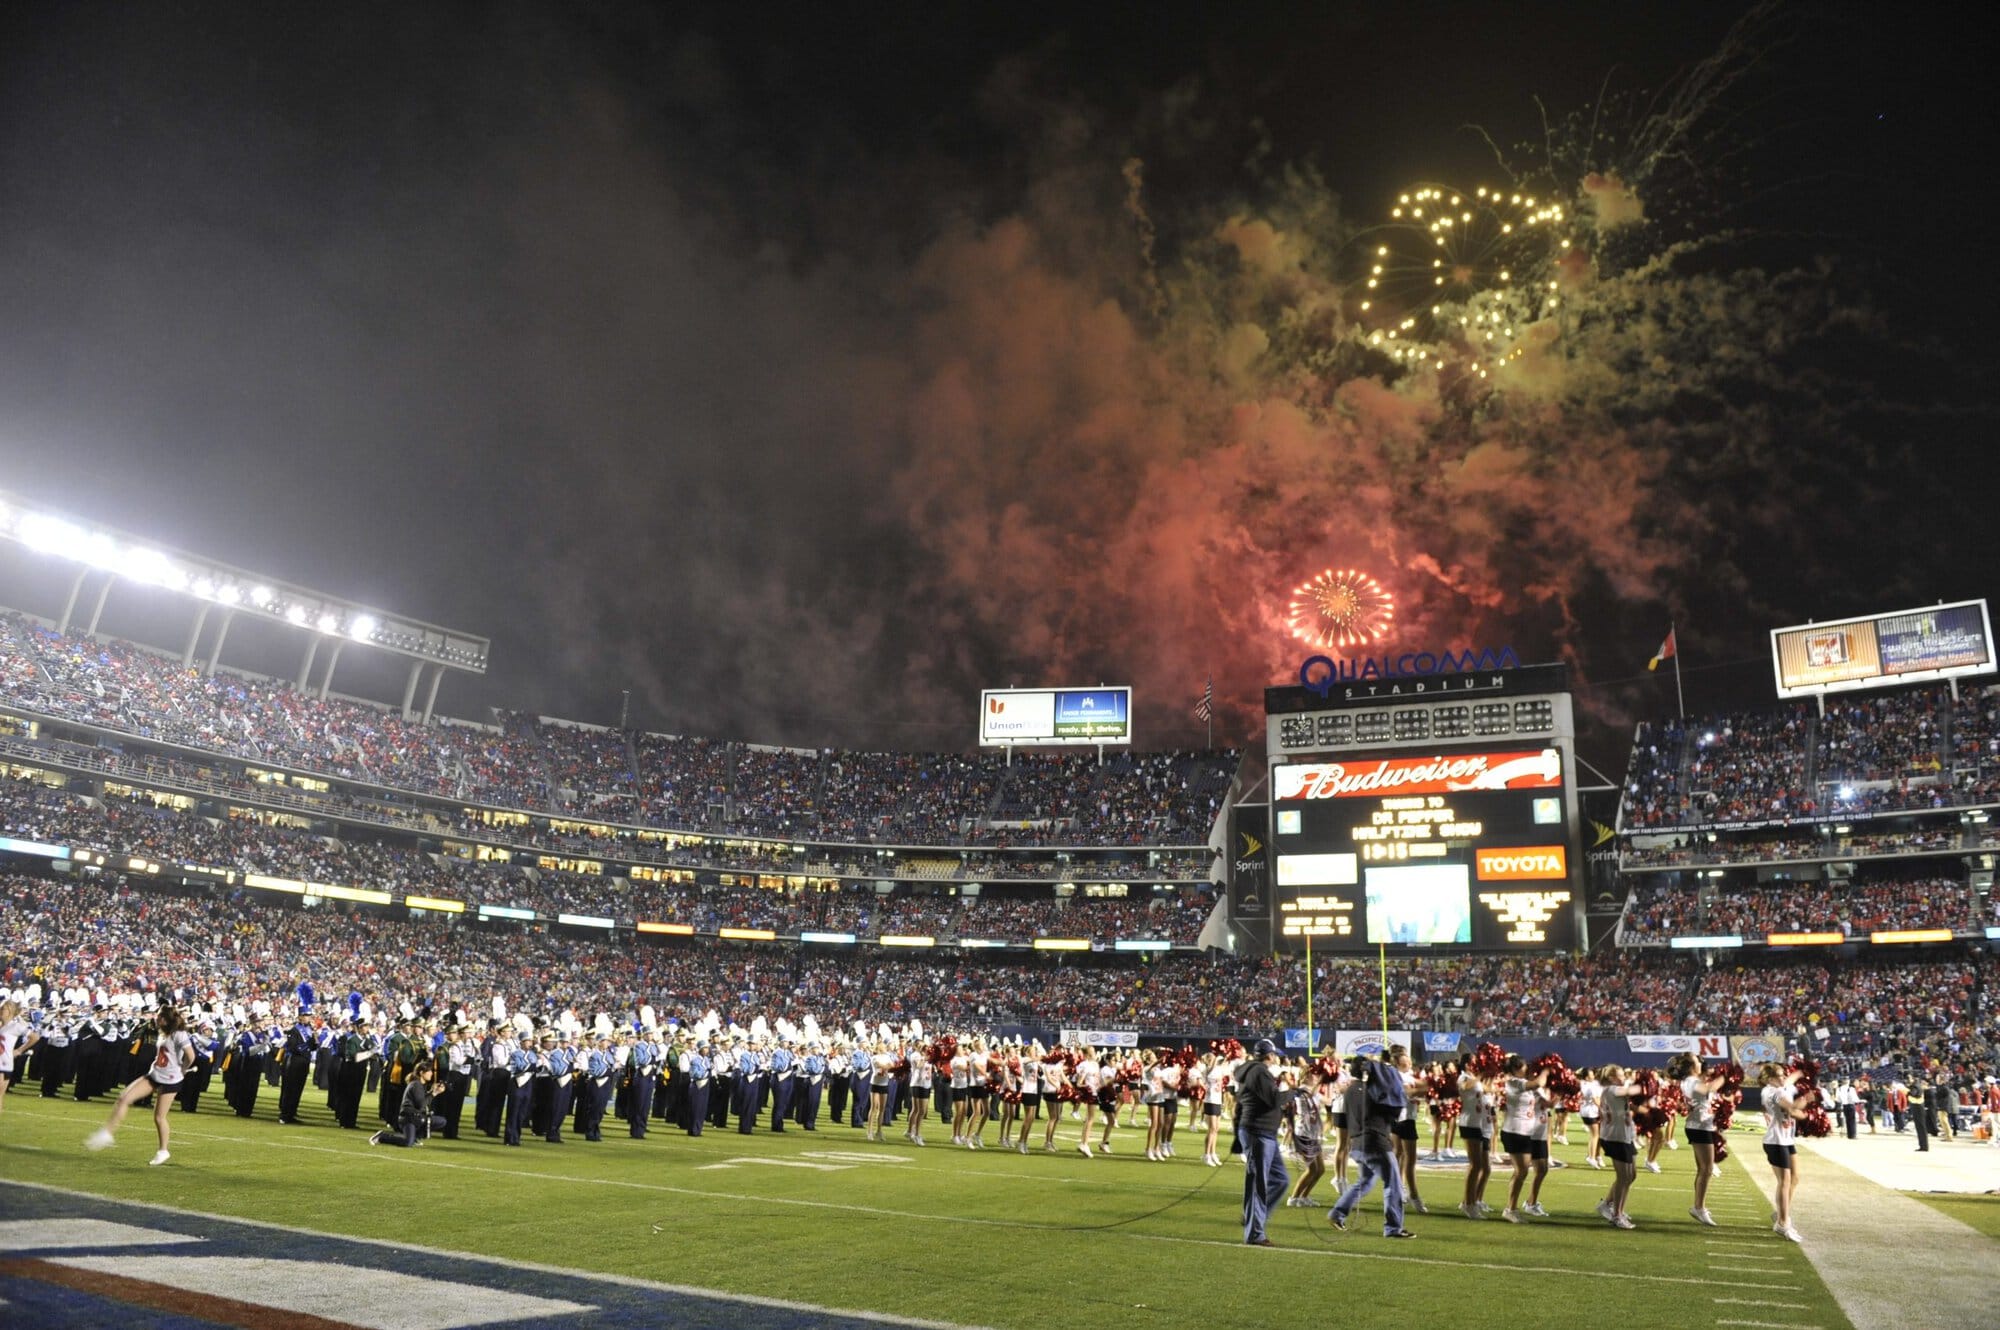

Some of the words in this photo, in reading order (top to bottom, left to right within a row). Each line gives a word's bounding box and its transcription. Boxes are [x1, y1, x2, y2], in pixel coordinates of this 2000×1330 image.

[1300, 646, 1520, 698] QUALCOMM
[1345, 676, 1504, 697] STADIUM
[1303, 756, 1488, 800] Budweiser
[1786, 816, 1815, 824] OCATION
[1480, 854, 1562, 873] TOYOTA
[1584, 850, 1620, 862] Sprint
[1235, 860, 1265, 872] Sprint
[1698, 1037, 1720, 1056] N
